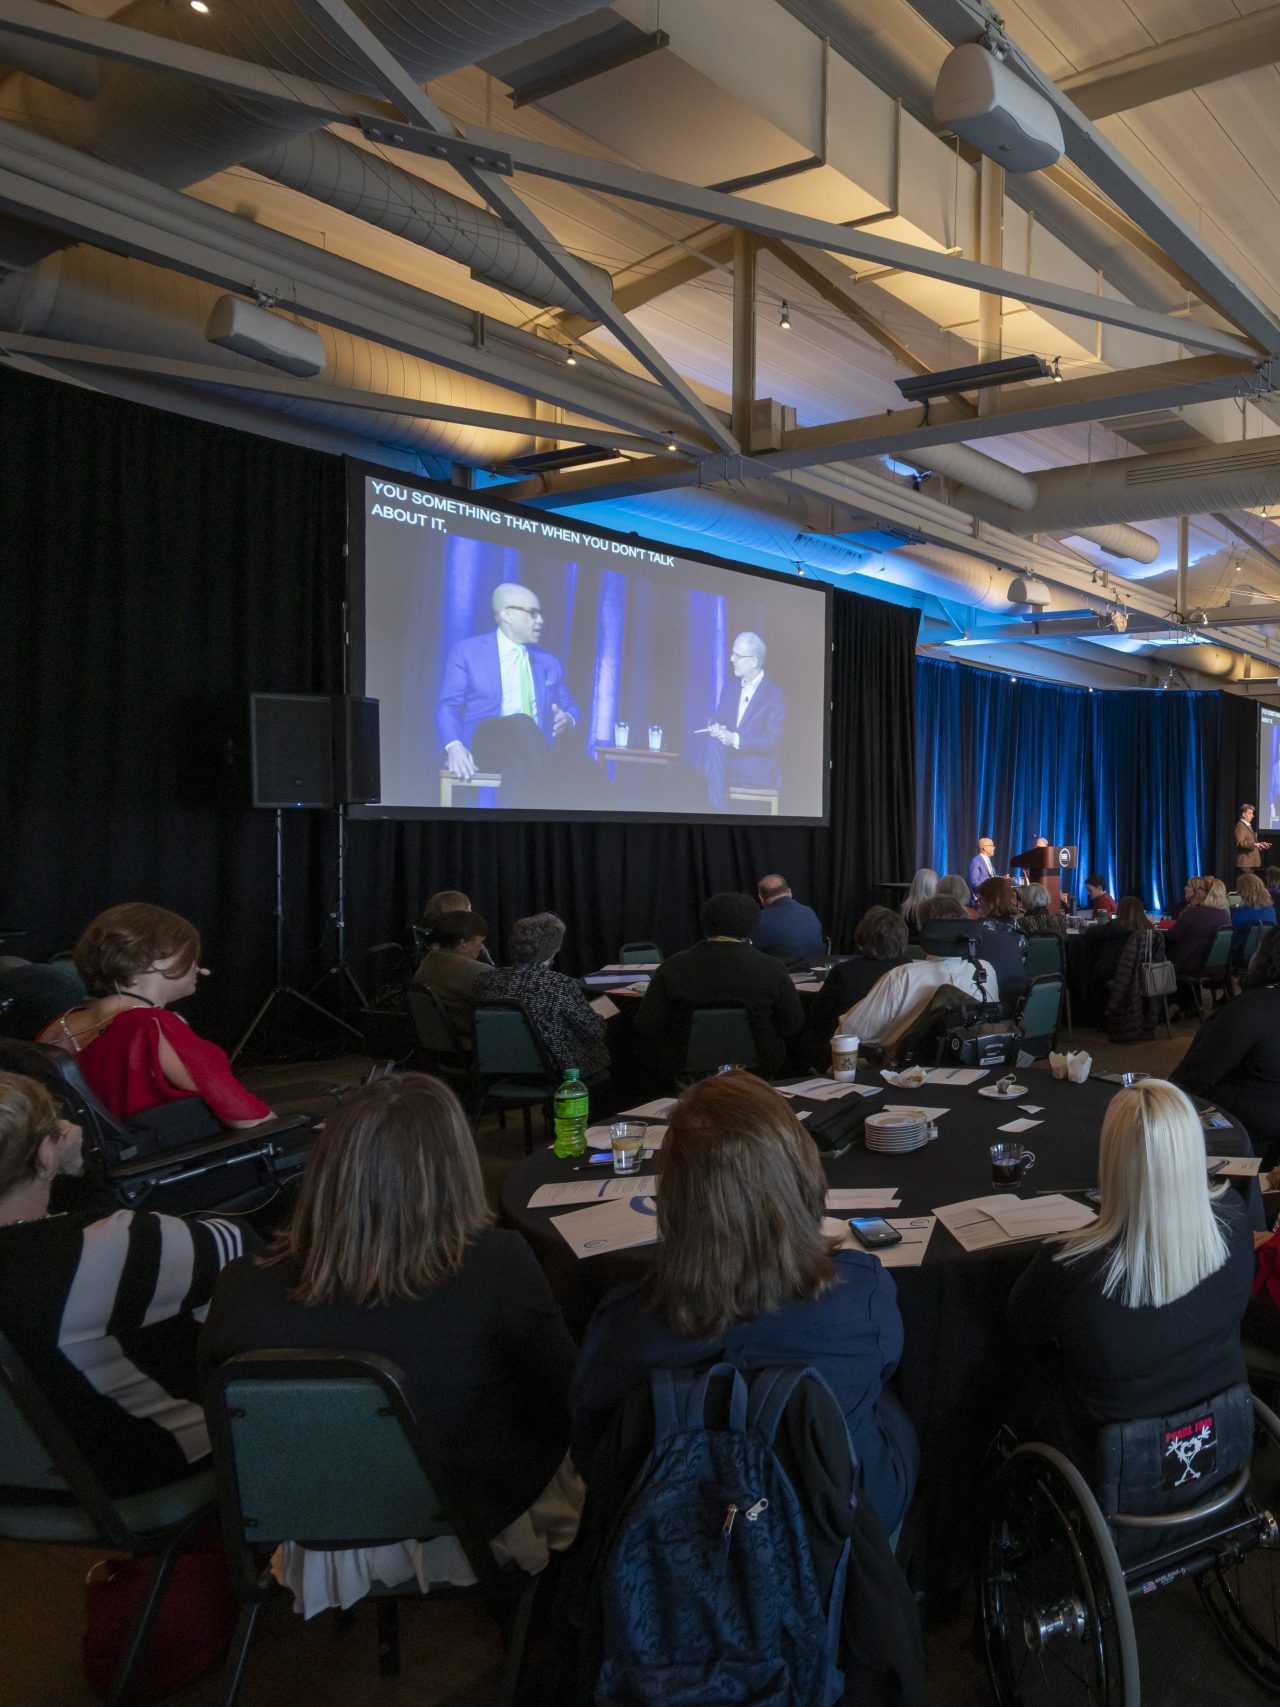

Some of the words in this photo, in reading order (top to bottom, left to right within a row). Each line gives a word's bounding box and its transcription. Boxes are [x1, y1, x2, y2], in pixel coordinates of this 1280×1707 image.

[371, 504, 428, 527] ABOUT
[431, 517, 447, 533] IT,
[371, 481, 408, 501] YOU
[412, 492, 501, 524] SOMETHING
[504, 515, 539, 534] THAT
[541, 525, 580, 544] WHEN
[583, 535, 609, 551] YOU
[611, 542, 646, 560] DON'T
[648, 551, 675, 567] TALK
